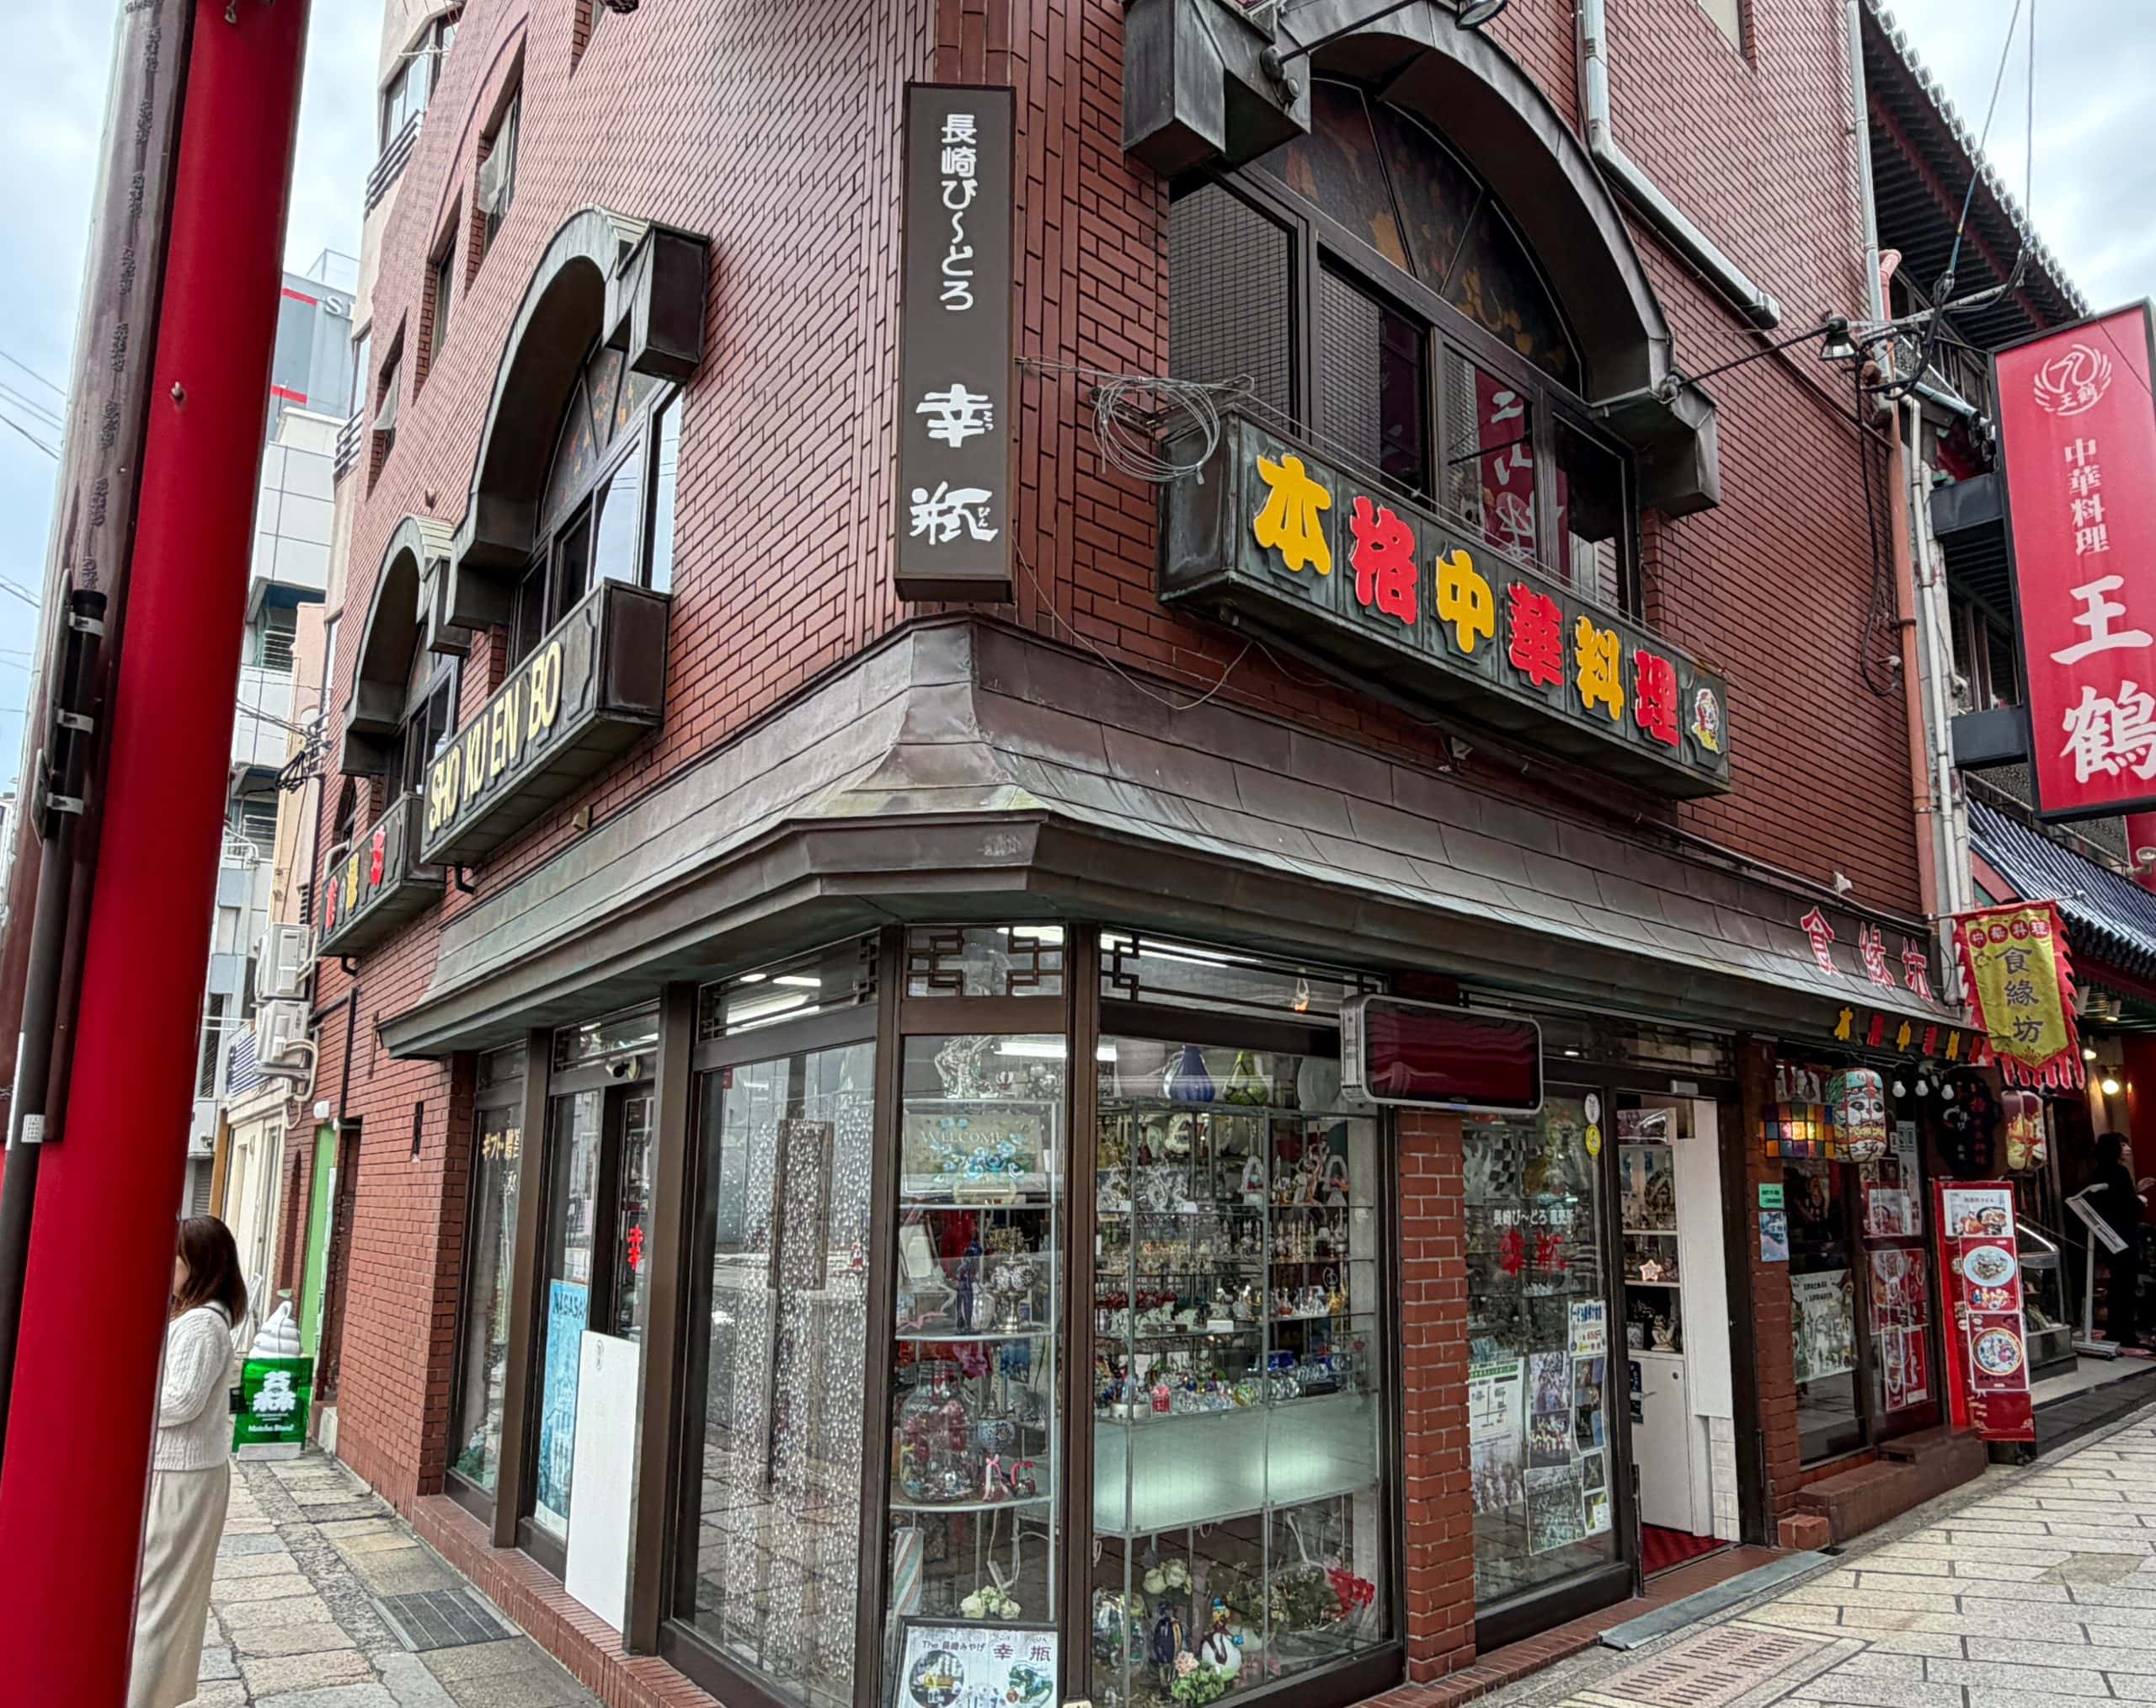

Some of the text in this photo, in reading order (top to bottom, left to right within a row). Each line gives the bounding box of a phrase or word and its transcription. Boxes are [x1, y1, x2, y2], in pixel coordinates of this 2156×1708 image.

[2058, 382, 2098, 410] 王鶴
[2064, 438, 2109, 556] 中華料理
[1254, 453, 1679, 747] 本格中華料理
[429, 641, 562, 832] SHO KU EN BO
[2050, 574, 2156, 783] 王鶴
[1972, 921, 2049, 945] 中華料理
[923, 1641, 938, 1649] The
